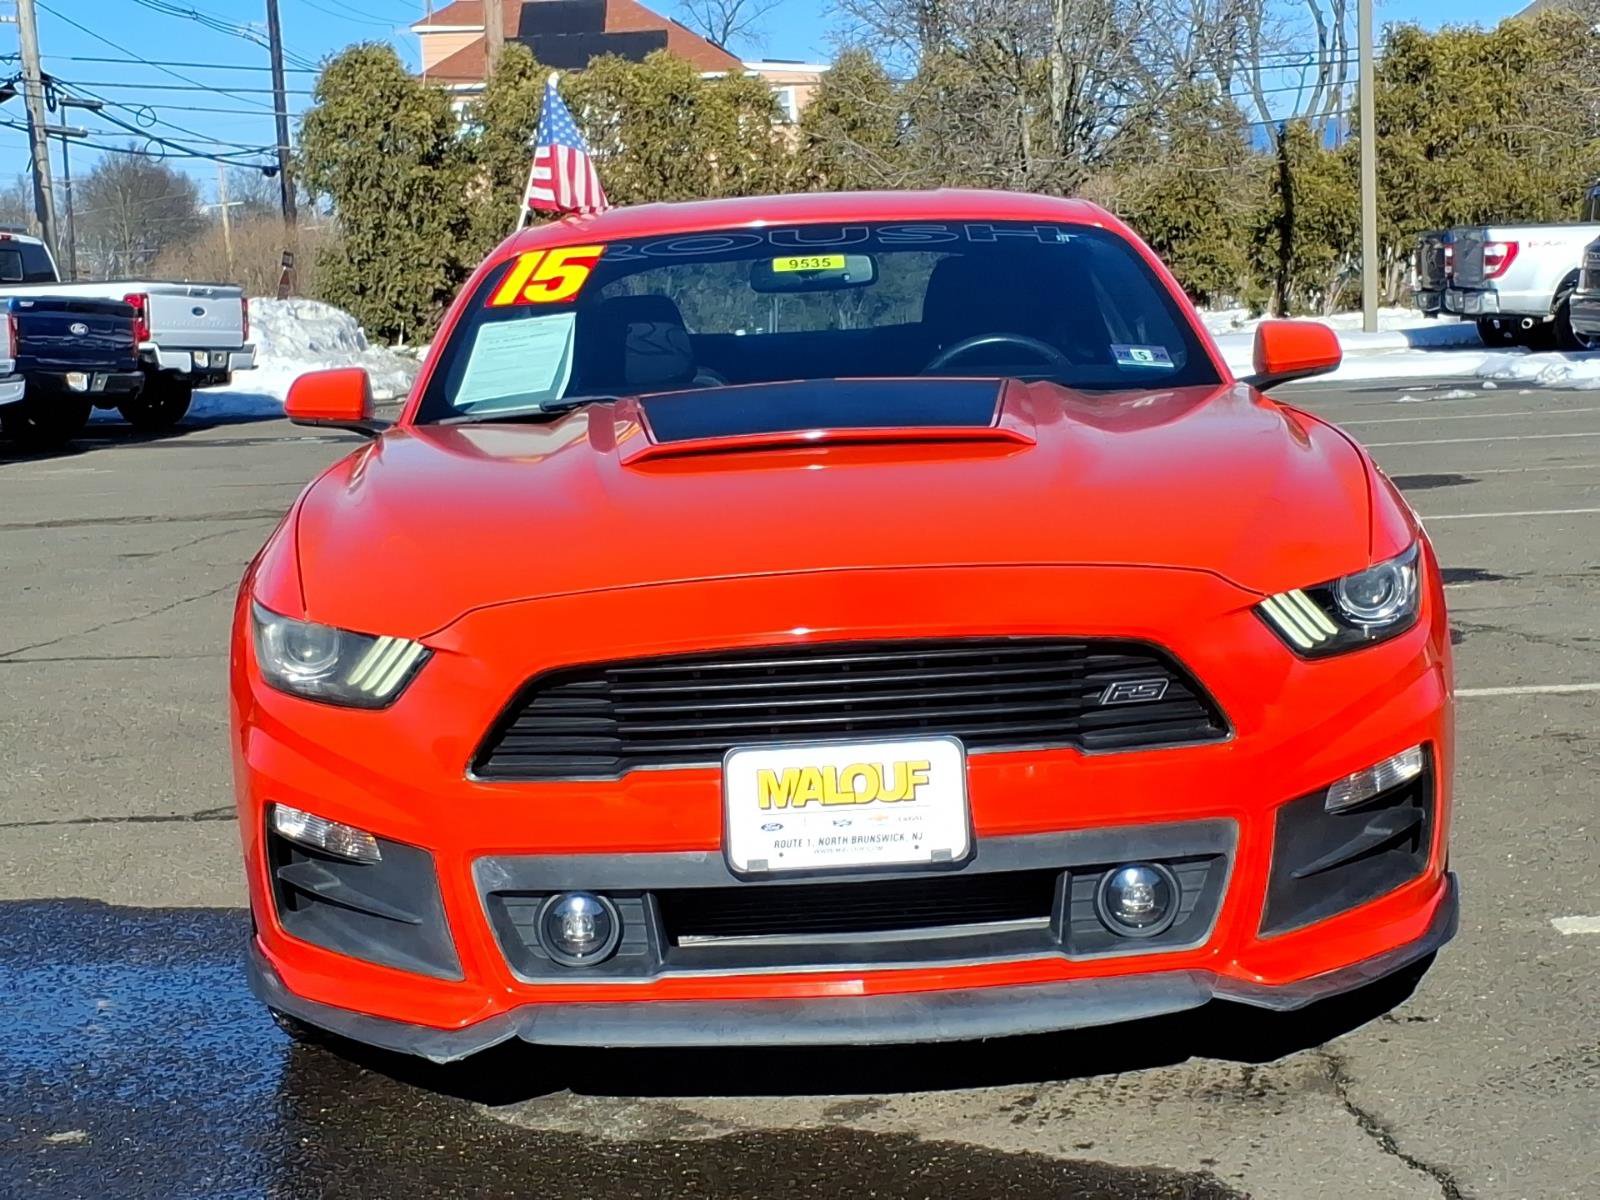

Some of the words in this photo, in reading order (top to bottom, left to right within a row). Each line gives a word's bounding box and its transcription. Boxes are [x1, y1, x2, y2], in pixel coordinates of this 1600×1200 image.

[788, 259, 832, 270] 9535
[492, 244, 605, 306] 15
[1110, 682, 1164, 701] RS
[757, 760, 931, 810] MALOUF
[774, 838, 802, 849] ROUTE
[818, 835, 848, 846] NORTH
[911, 832, 924, 841] NJ
